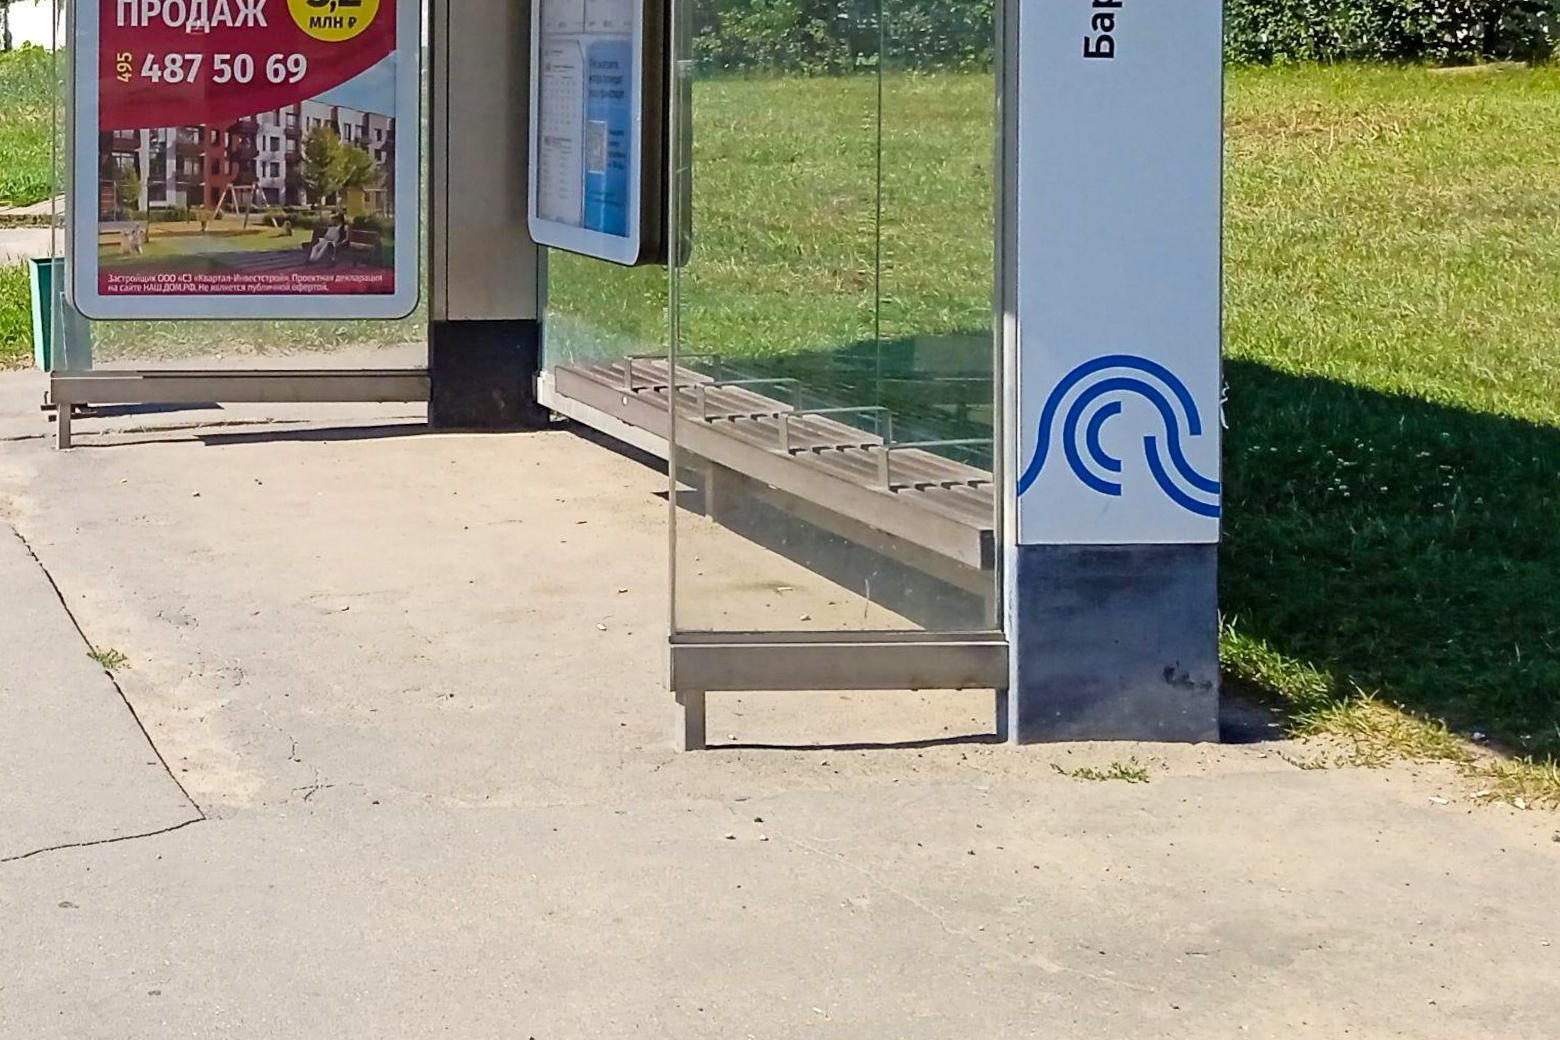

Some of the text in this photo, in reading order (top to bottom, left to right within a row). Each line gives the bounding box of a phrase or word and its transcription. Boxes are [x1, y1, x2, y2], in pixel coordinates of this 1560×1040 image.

[309, 16, 344, 29] МЛН
[116, 51, 133, 83] 495
[140, 53, 308, 84] 487 50 69
[157, 273, 176, 283] ООО
